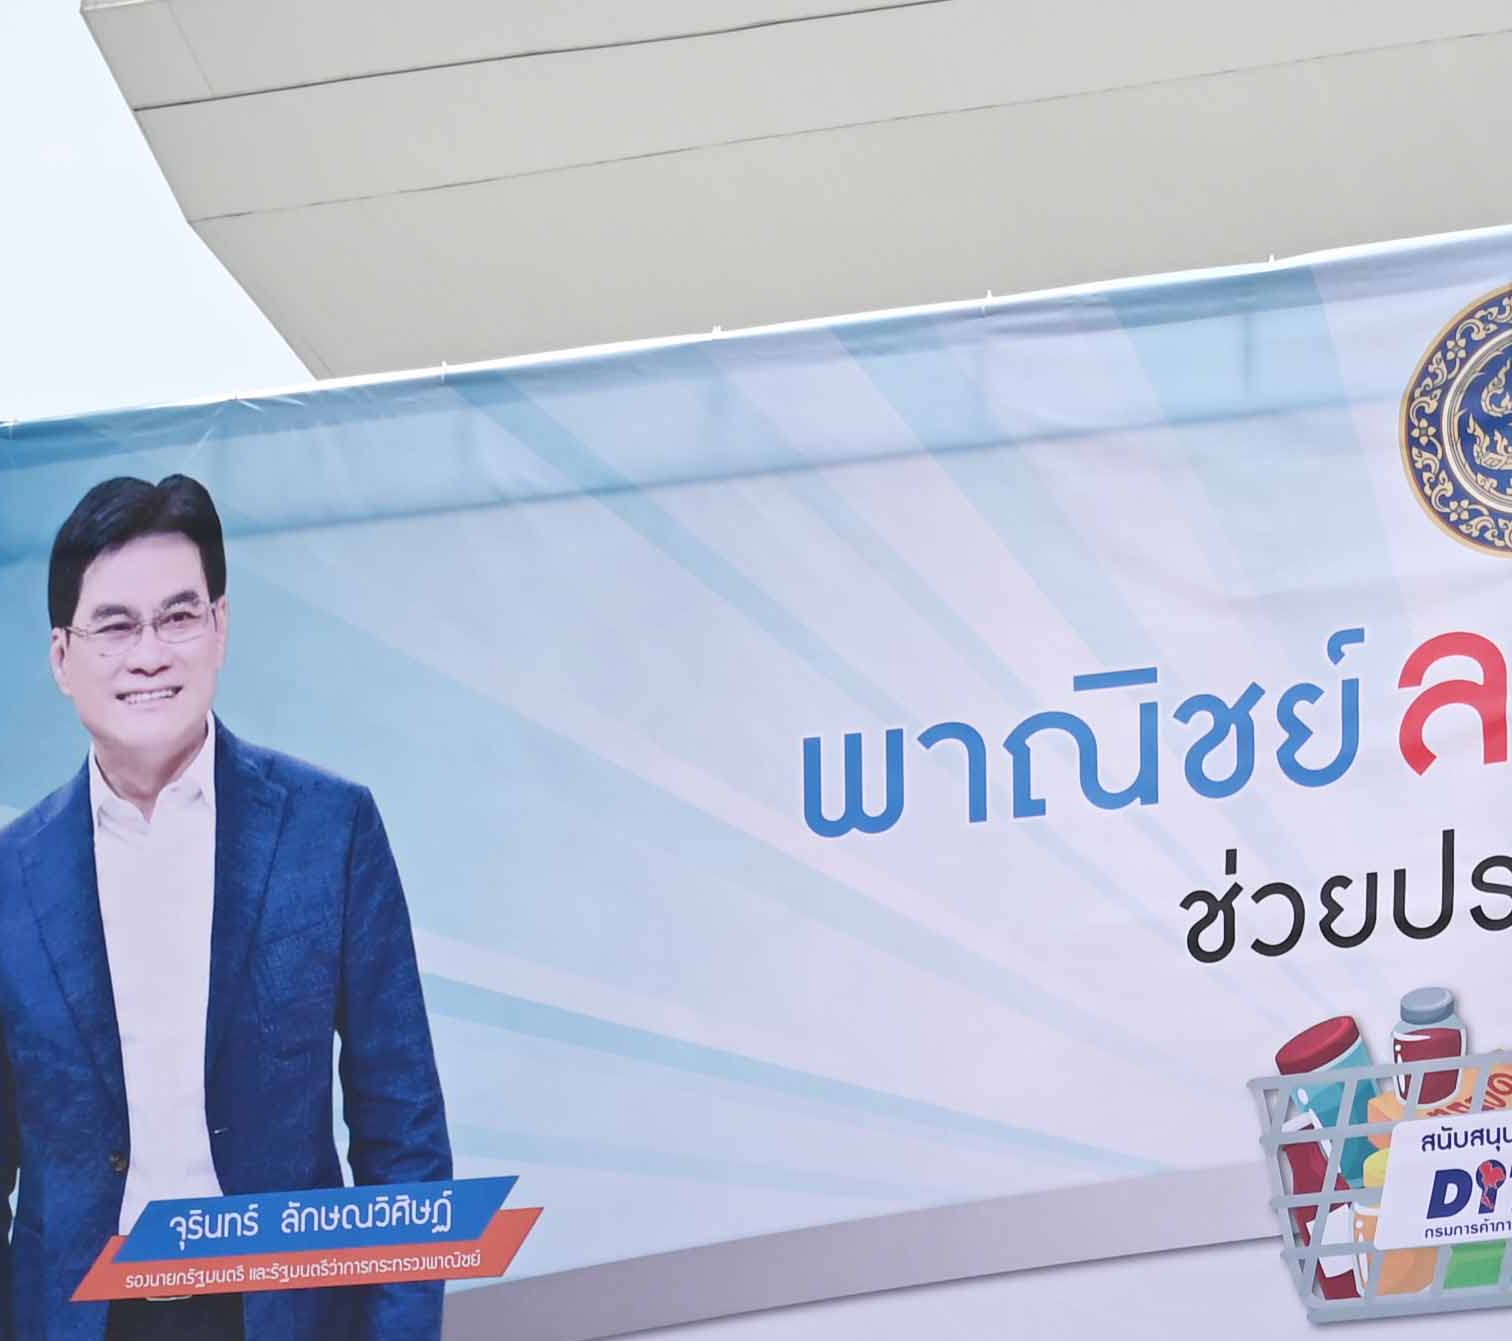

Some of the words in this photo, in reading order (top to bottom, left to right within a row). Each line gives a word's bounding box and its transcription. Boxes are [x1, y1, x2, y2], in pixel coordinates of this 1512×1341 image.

[168, 1203, 260, 1251] จุรินทร์
[124, 1265, 246, 1290] รองนายกรัฐมนตรี
